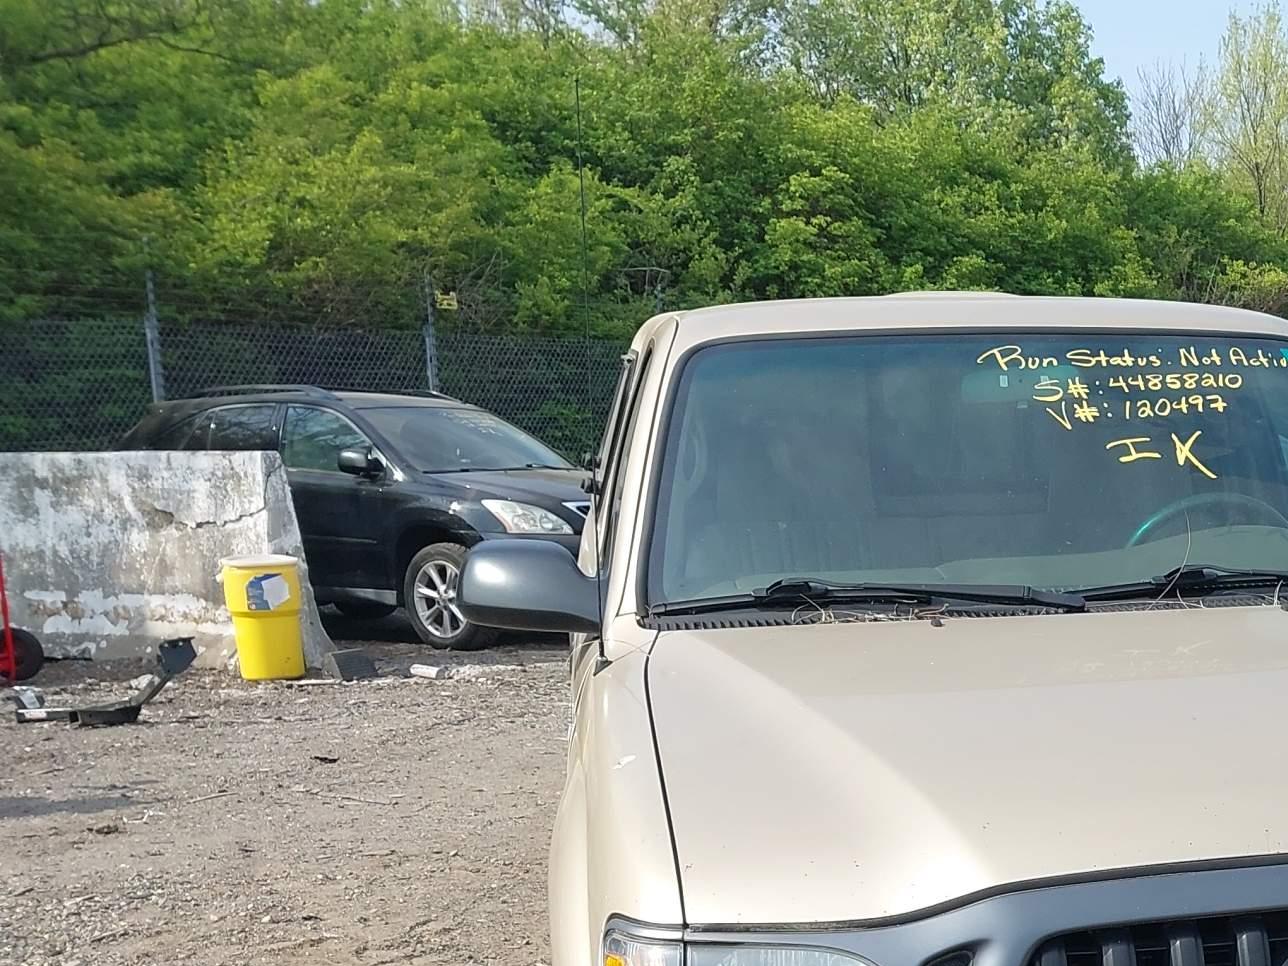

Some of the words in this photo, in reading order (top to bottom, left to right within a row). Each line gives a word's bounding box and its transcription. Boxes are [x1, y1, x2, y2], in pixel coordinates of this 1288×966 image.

[976, 345, 1058, 371] Run
[1179, 346, 1222, 367] Not
[1108, 373, 1243, 393] 44858210
[1125, 394, 1228, 420] 120497
